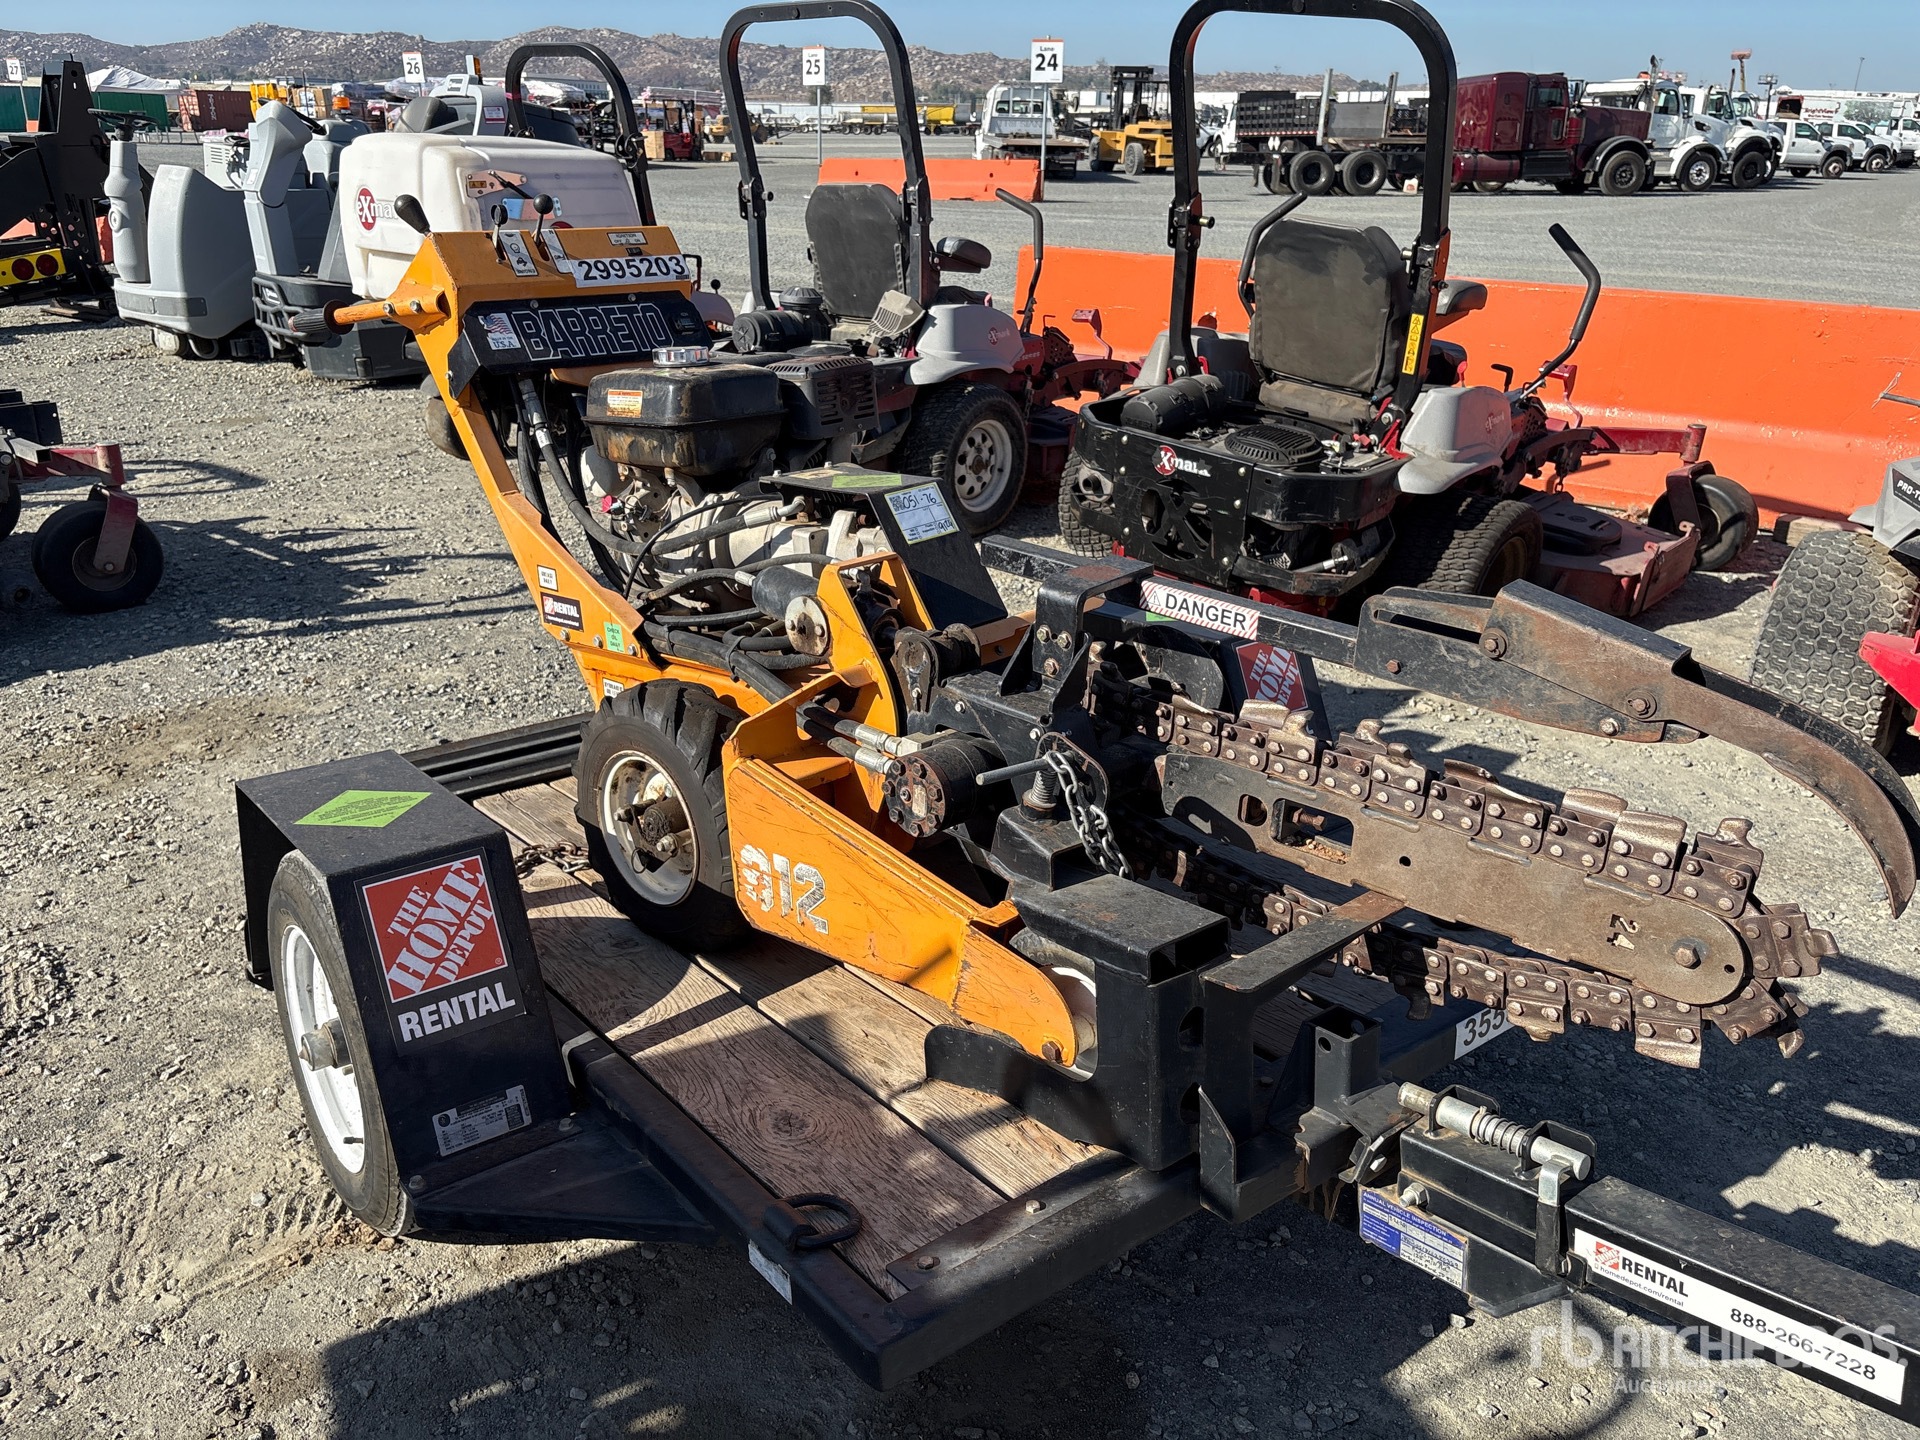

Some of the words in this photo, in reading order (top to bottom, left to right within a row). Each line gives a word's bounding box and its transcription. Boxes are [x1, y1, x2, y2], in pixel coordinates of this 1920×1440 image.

[9, 65, 19, 75] 27
[406, 62, 421, 75] 26
[806, 59, 821, 75] 25
[1035, 53, 1058, 71] 24
[357, 195, 399, 224] eXmar
[577, 256, 686, 282] 2995203
[511, 303, 675, 362] BARRETO
[1896, 479, 1920, 501] PRO-T
[554, 601, 580, 618] RENTAL
[1165, 593, 1247, 630] DANGER
[1250, 649, 1269, 683] THE
[387, 885, 432, 937] THE
[387, 861, 486, 994] HOME
[435, 899, 494, 983] DEPOT
[397, 981, 516, 1043] RENTAL
[1363, 1192, 1387, 1207] ANNUAL
[1386, 1204, 1411, 1219] VEHICLE
[1411, 1214, 1447, 1237] INSPECTION
[1600, 1266, 1684, 1307] homedepot.com/rental
[1622, 1256, 1689, 1298] RENTAL
[1730, 1308, 1876, 1381] 888-266-7228
